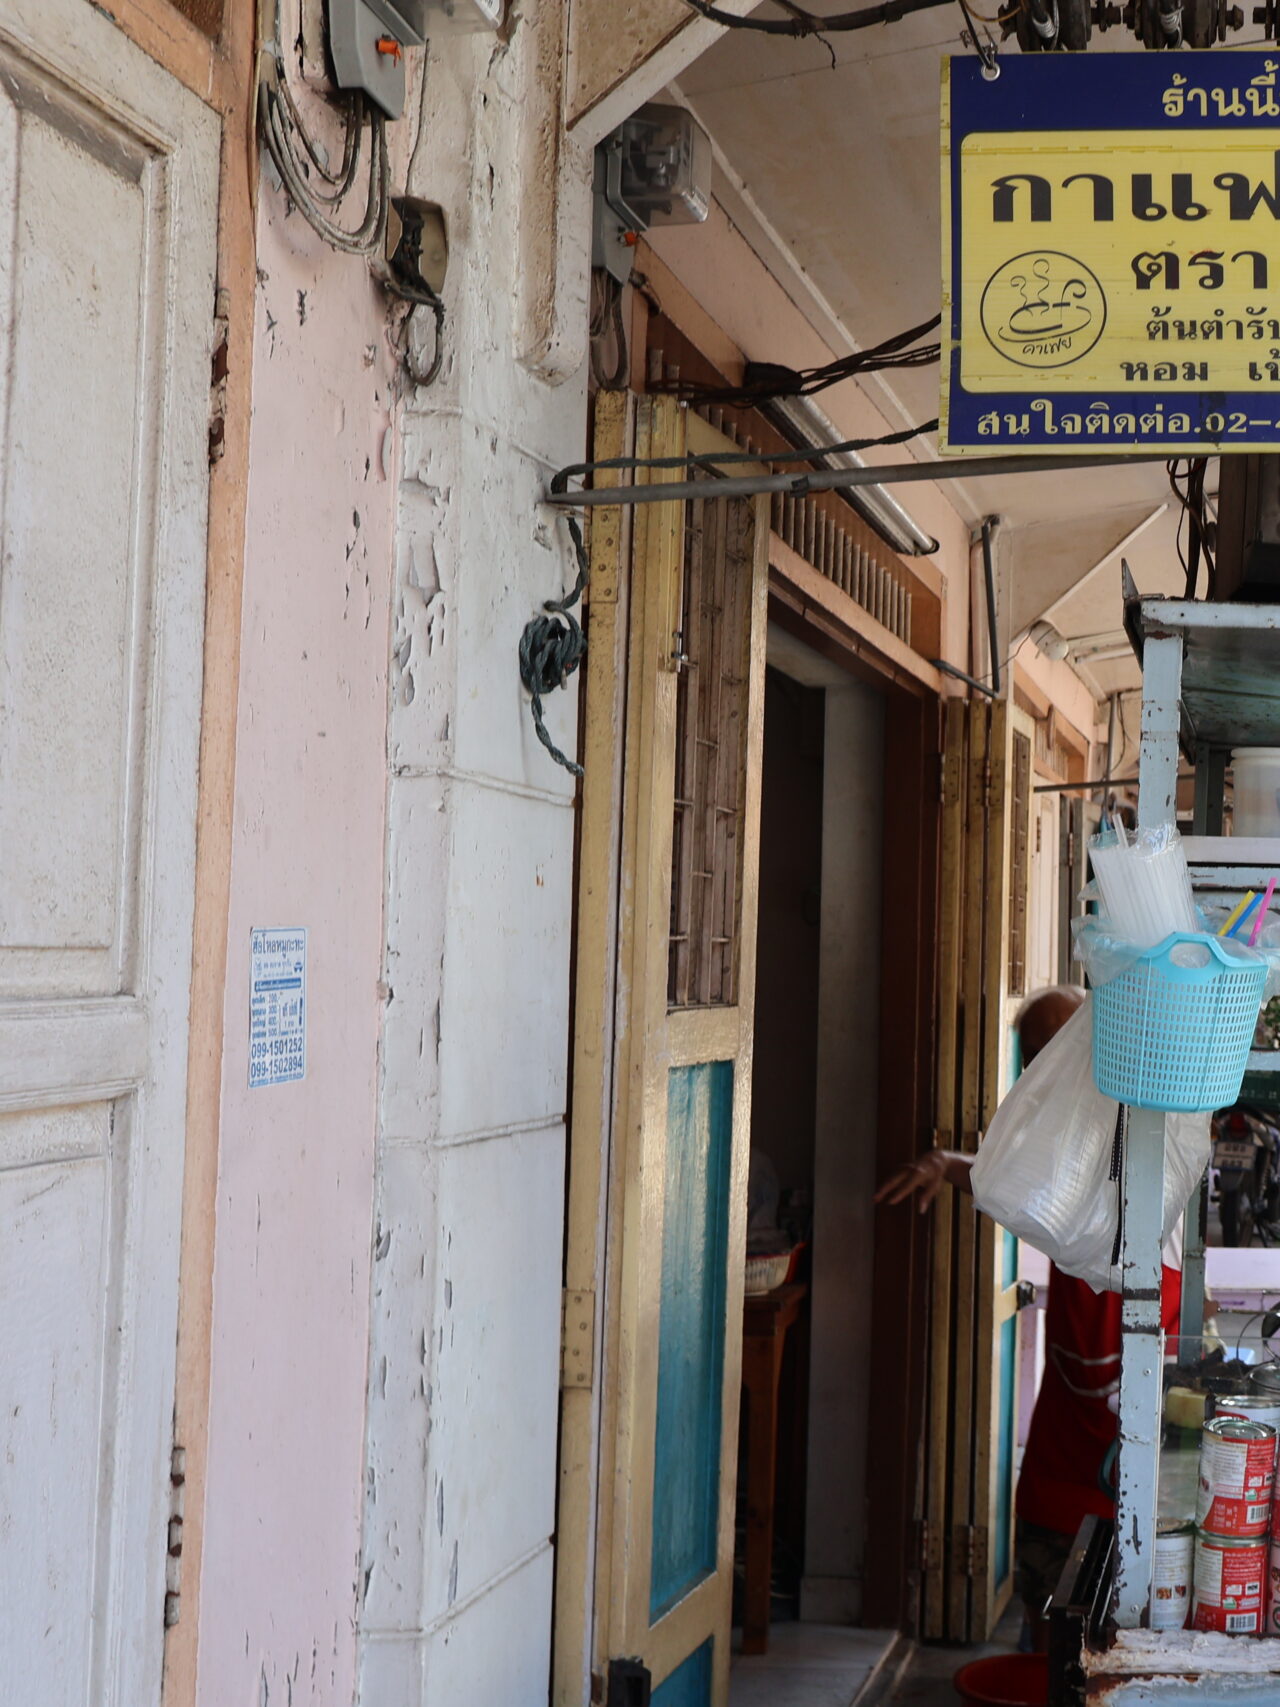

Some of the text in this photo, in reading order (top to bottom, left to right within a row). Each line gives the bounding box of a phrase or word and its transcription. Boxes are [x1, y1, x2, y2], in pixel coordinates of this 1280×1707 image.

[1131, 250, 1268, 290] ตรา
[1119, 360, 1209, 382] หอม
[251, 1037, 303, 1060] 099-1501252
[250, 1056, 303, 1079] 099-1502894
